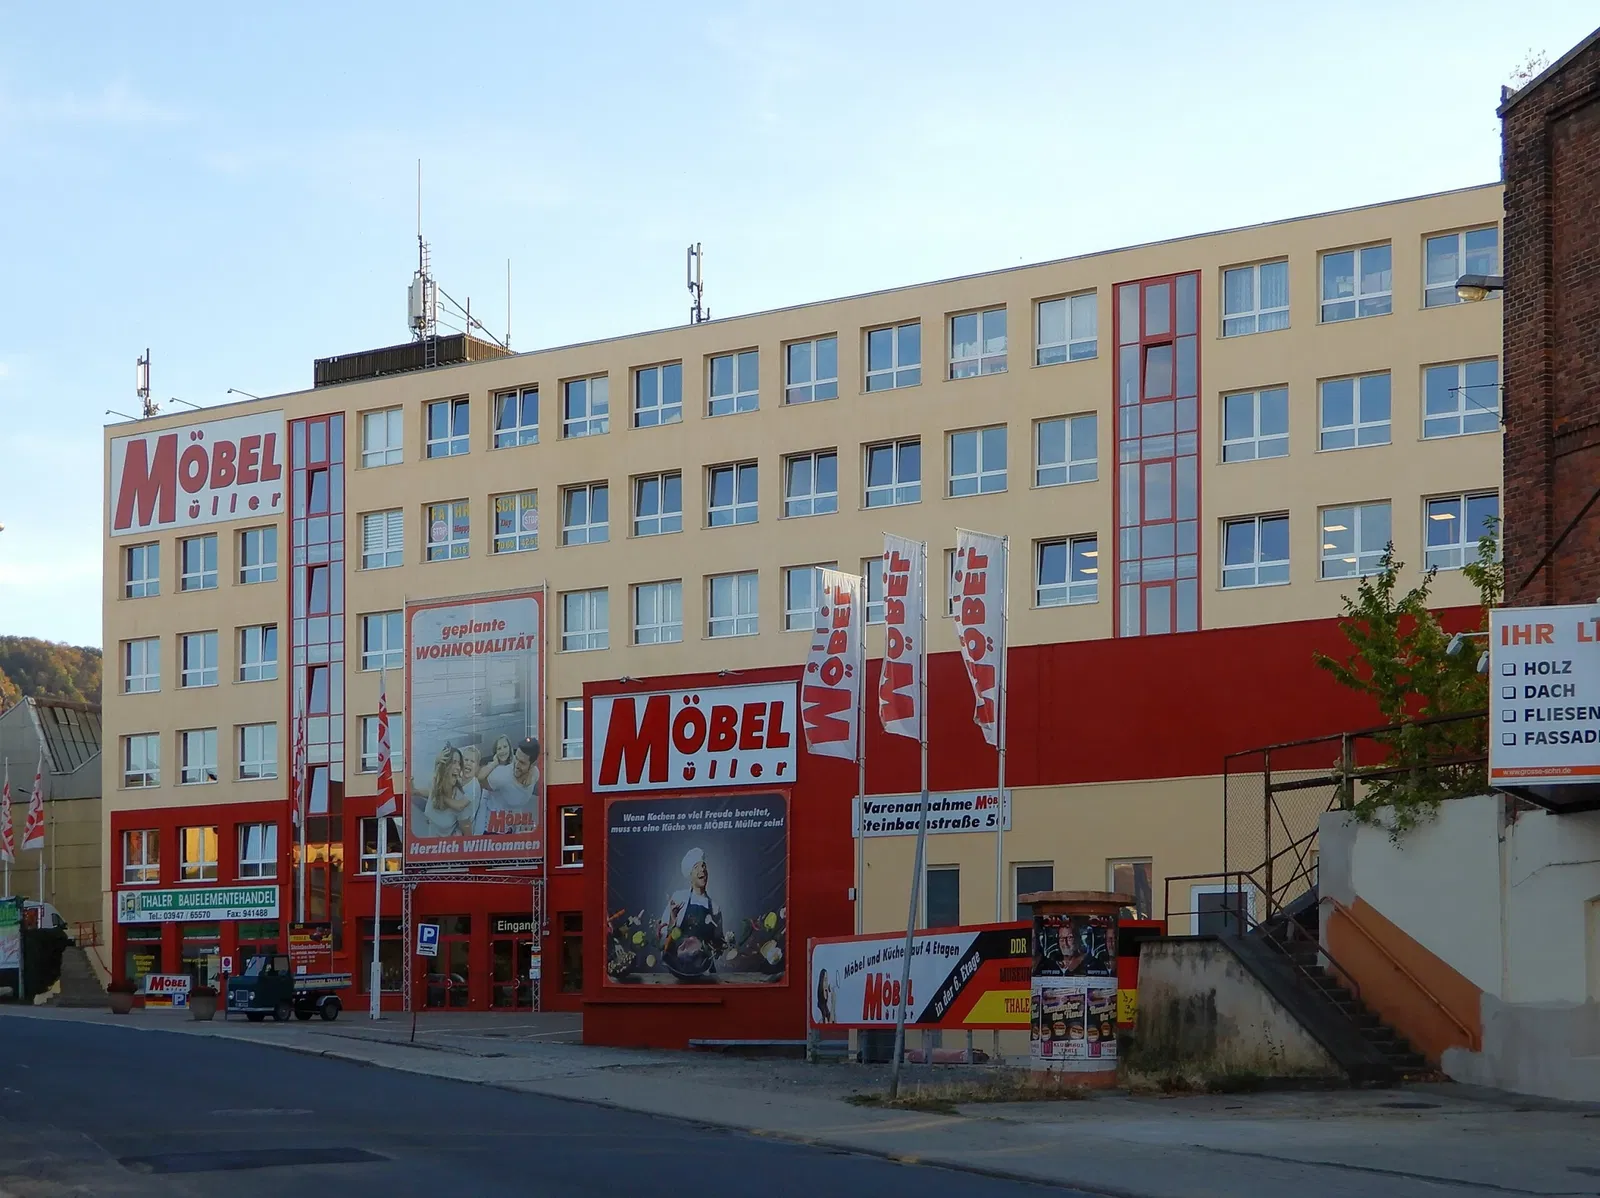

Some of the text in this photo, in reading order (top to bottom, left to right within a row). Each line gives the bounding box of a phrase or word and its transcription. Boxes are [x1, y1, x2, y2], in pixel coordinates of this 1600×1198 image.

[114, 429, 282, 530] MÖBEL
[442, 619, 506, 640] geplante
[1501, 623, 1554, 646] IHR
[416, 632, 535, 660] WOHNQUALITÄT
[1524, 660, 1572, 676] HOLZ
[1524, 684, 1576, 699] DACH
[598, 694, 790, 786] MÖBEL
[623, 813, 646, 823] Wenn
[647, 812, 676, 822] Kochen
[688, 810, 703, 820] viel
[704, 809, 733, 819] Freude
[610, 817, 784, 833] muss es eine Küche von MÖBEL Müller sein!
[410, 839, 540, 855] Herzlich Willkommen
[142, 890, 275, 908] THALER BAUELEMENTEHANDEL
[163, 911, 184, 919] 03947
[190, 910, 211, 919] 65570
[226, 909, 242, 918] Fax:
[242, 908, 268, 917] 941488
[497, 920, 538, 933] Eingang
[1010, 937, 1027, 954] DDR
[843, 955, 865, 979] Möbel
[867, 949, 881, 967] und
[925, 942, 931, 954] 4
[932, 941, 960, 958] Etagen
[935, 951, 981, 1018] in der 6. Etage
[863, 972, 914, 1021] MÖBL
[1004, 998, 1029, 1013] THALE
